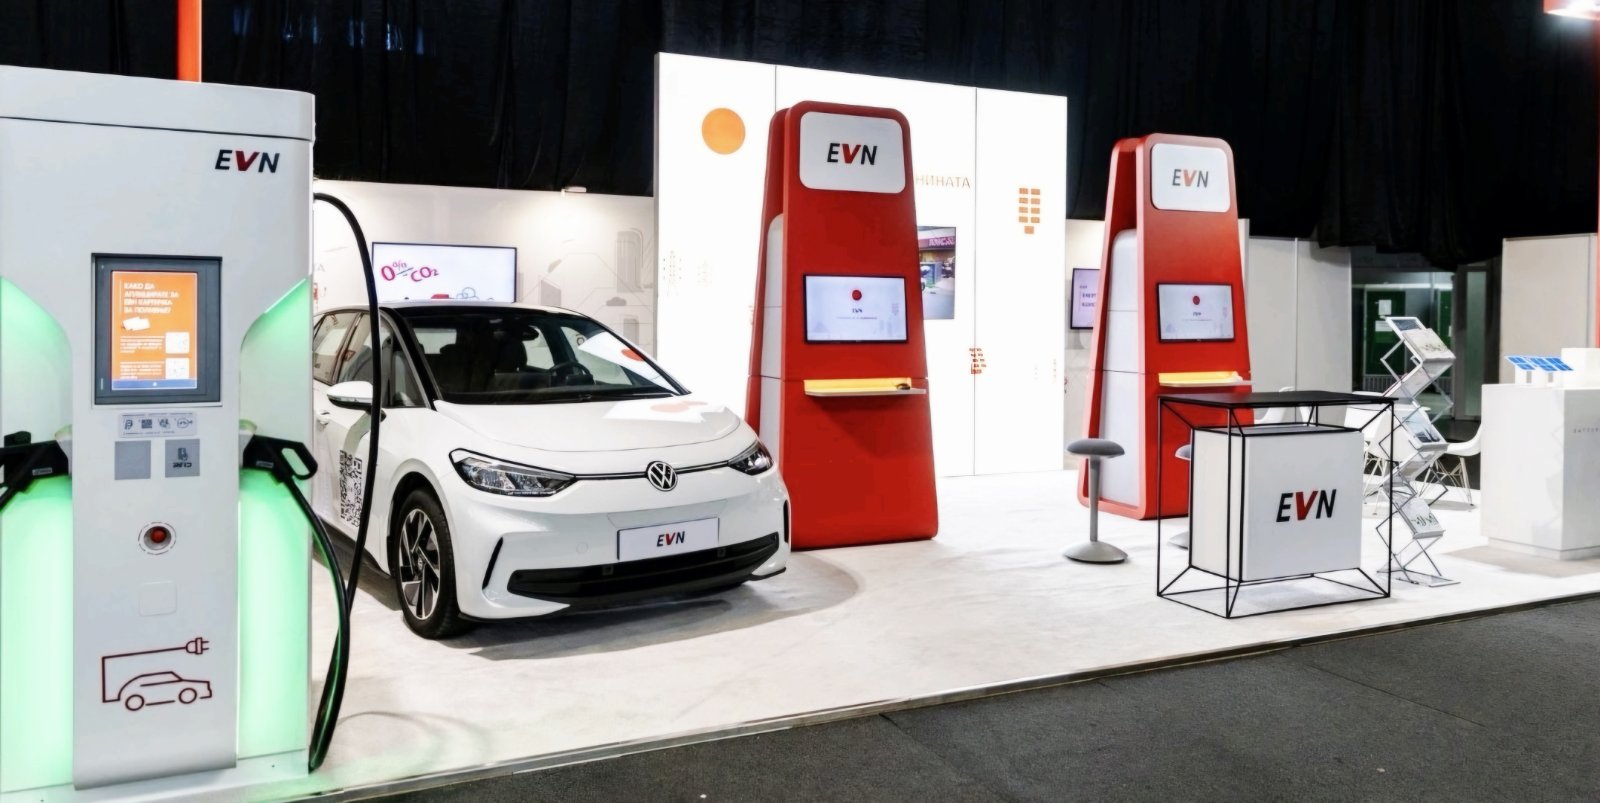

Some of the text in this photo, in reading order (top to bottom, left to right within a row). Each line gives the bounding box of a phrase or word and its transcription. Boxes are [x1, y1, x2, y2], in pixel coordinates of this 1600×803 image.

[214, 149, 280, 173] EVN
[827, 143, 878, 166] EVN
[915, 174, 971, 188] НИНАТА
[1172, 168, 1209, 188] EVN
[1276, 489, 1337, 523] EVN
[656, 531, 685, 547] EVN
